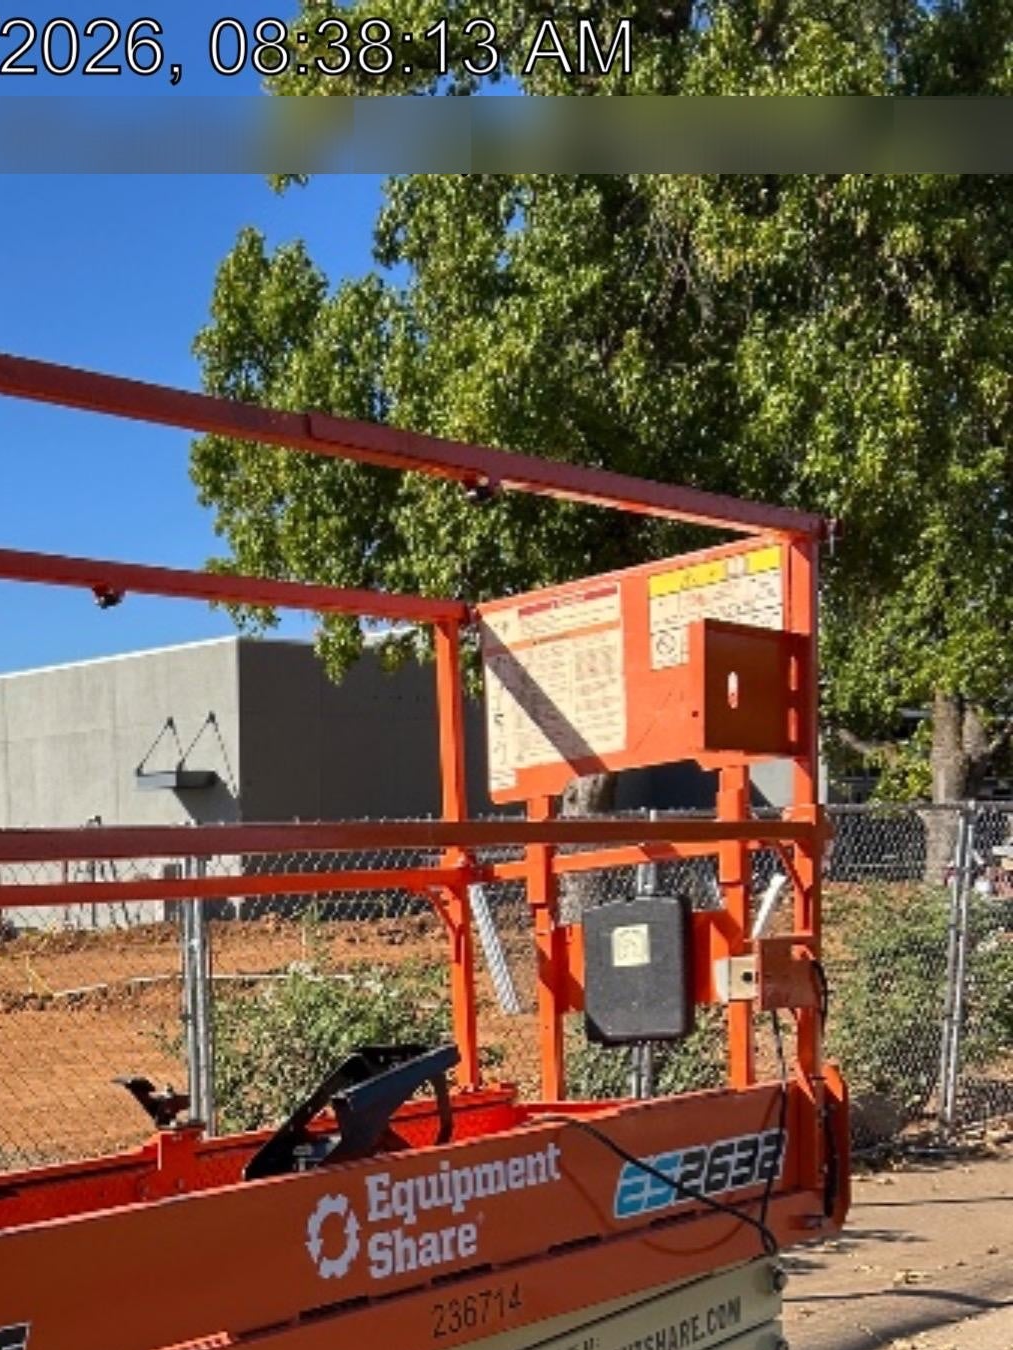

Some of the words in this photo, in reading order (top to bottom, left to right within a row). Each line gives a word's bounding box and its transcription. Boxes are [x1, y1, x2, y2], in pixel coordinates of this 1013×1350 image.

[365, 1142, 561, 1221] Equipment
[369, 1222, 476, 1279] Share
[431, 1284, 521, 1339] 236714
